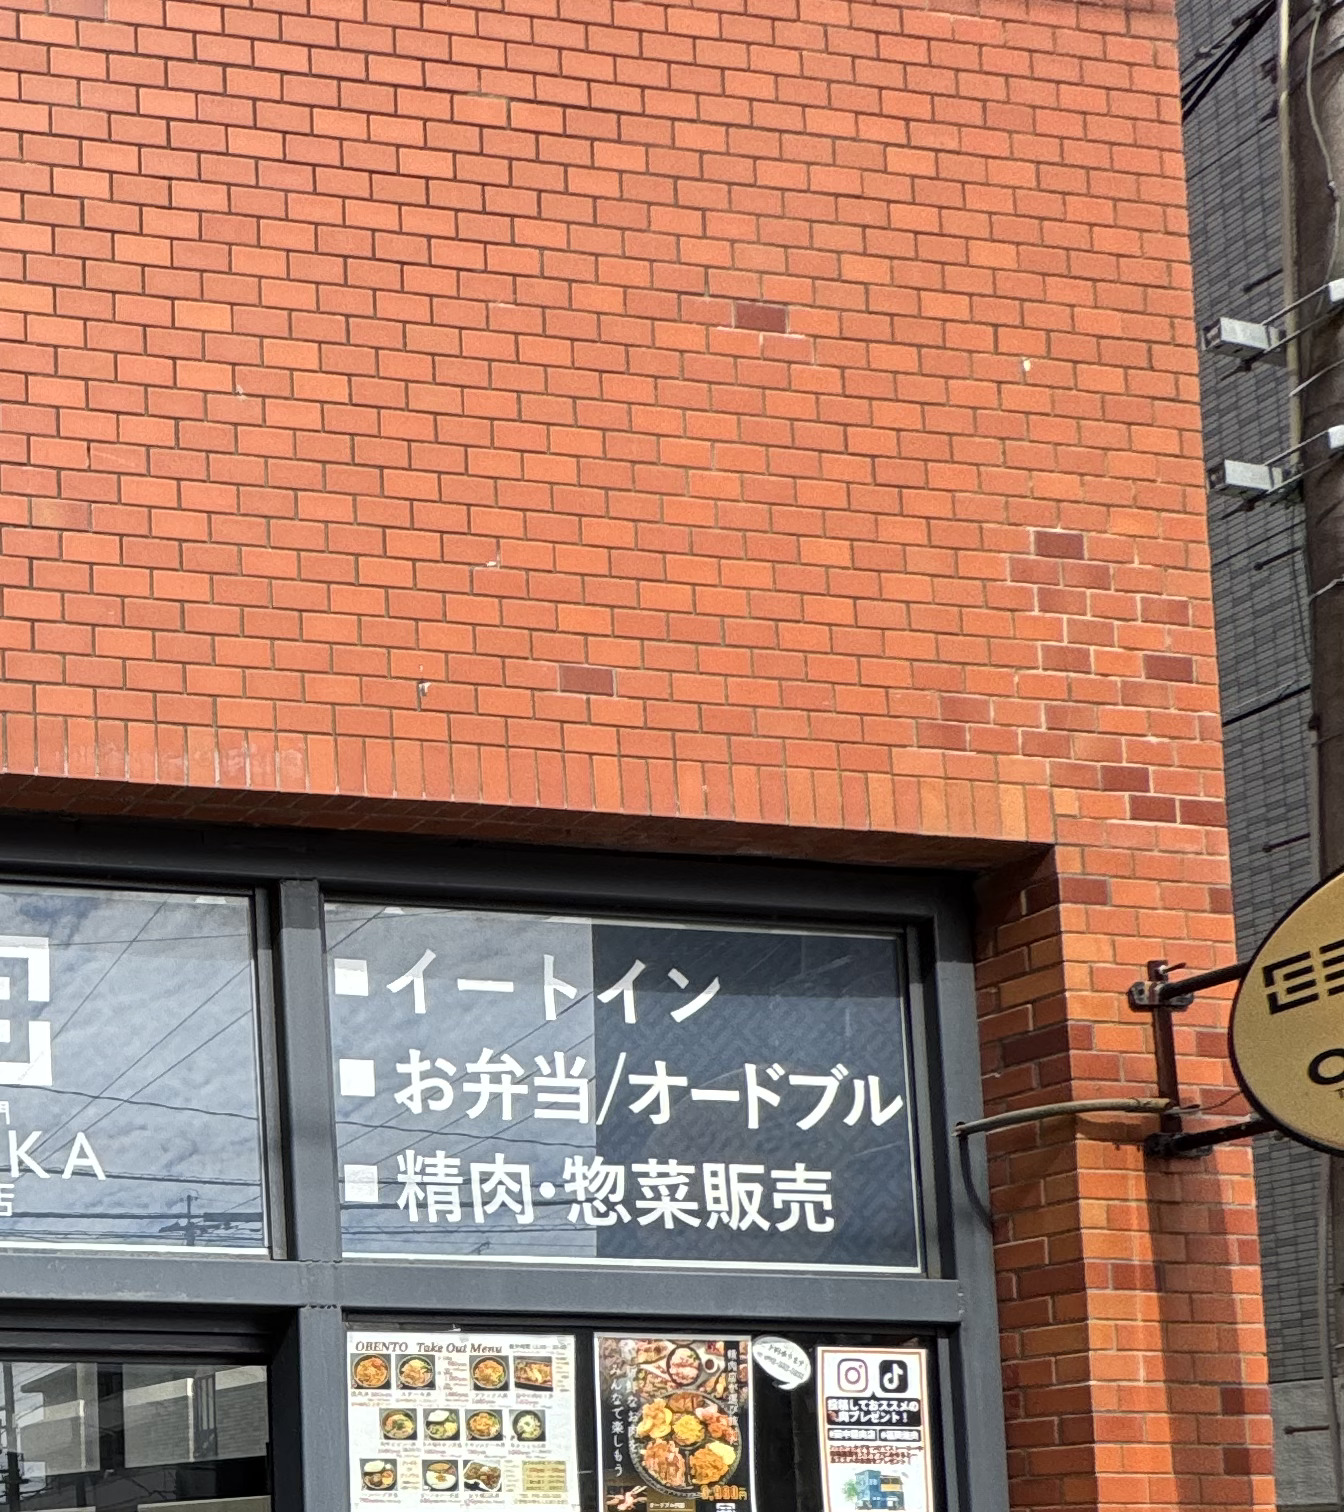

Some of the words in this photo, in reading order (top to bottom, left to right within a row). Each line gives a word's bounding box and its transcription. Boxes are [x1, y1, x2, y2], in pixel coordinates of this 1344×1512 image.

[386, 948, 721, 1024] イートイン
[393, 1048, 904, 1130] お弁当/オードブル
[355, 1341, 408, 1353] OBENTO
[416, 1342, 445, 1354] Take
[469, 1343, 503, 1355] Menu
[609, 1364, 625, 1477] みんなで楽しもう
